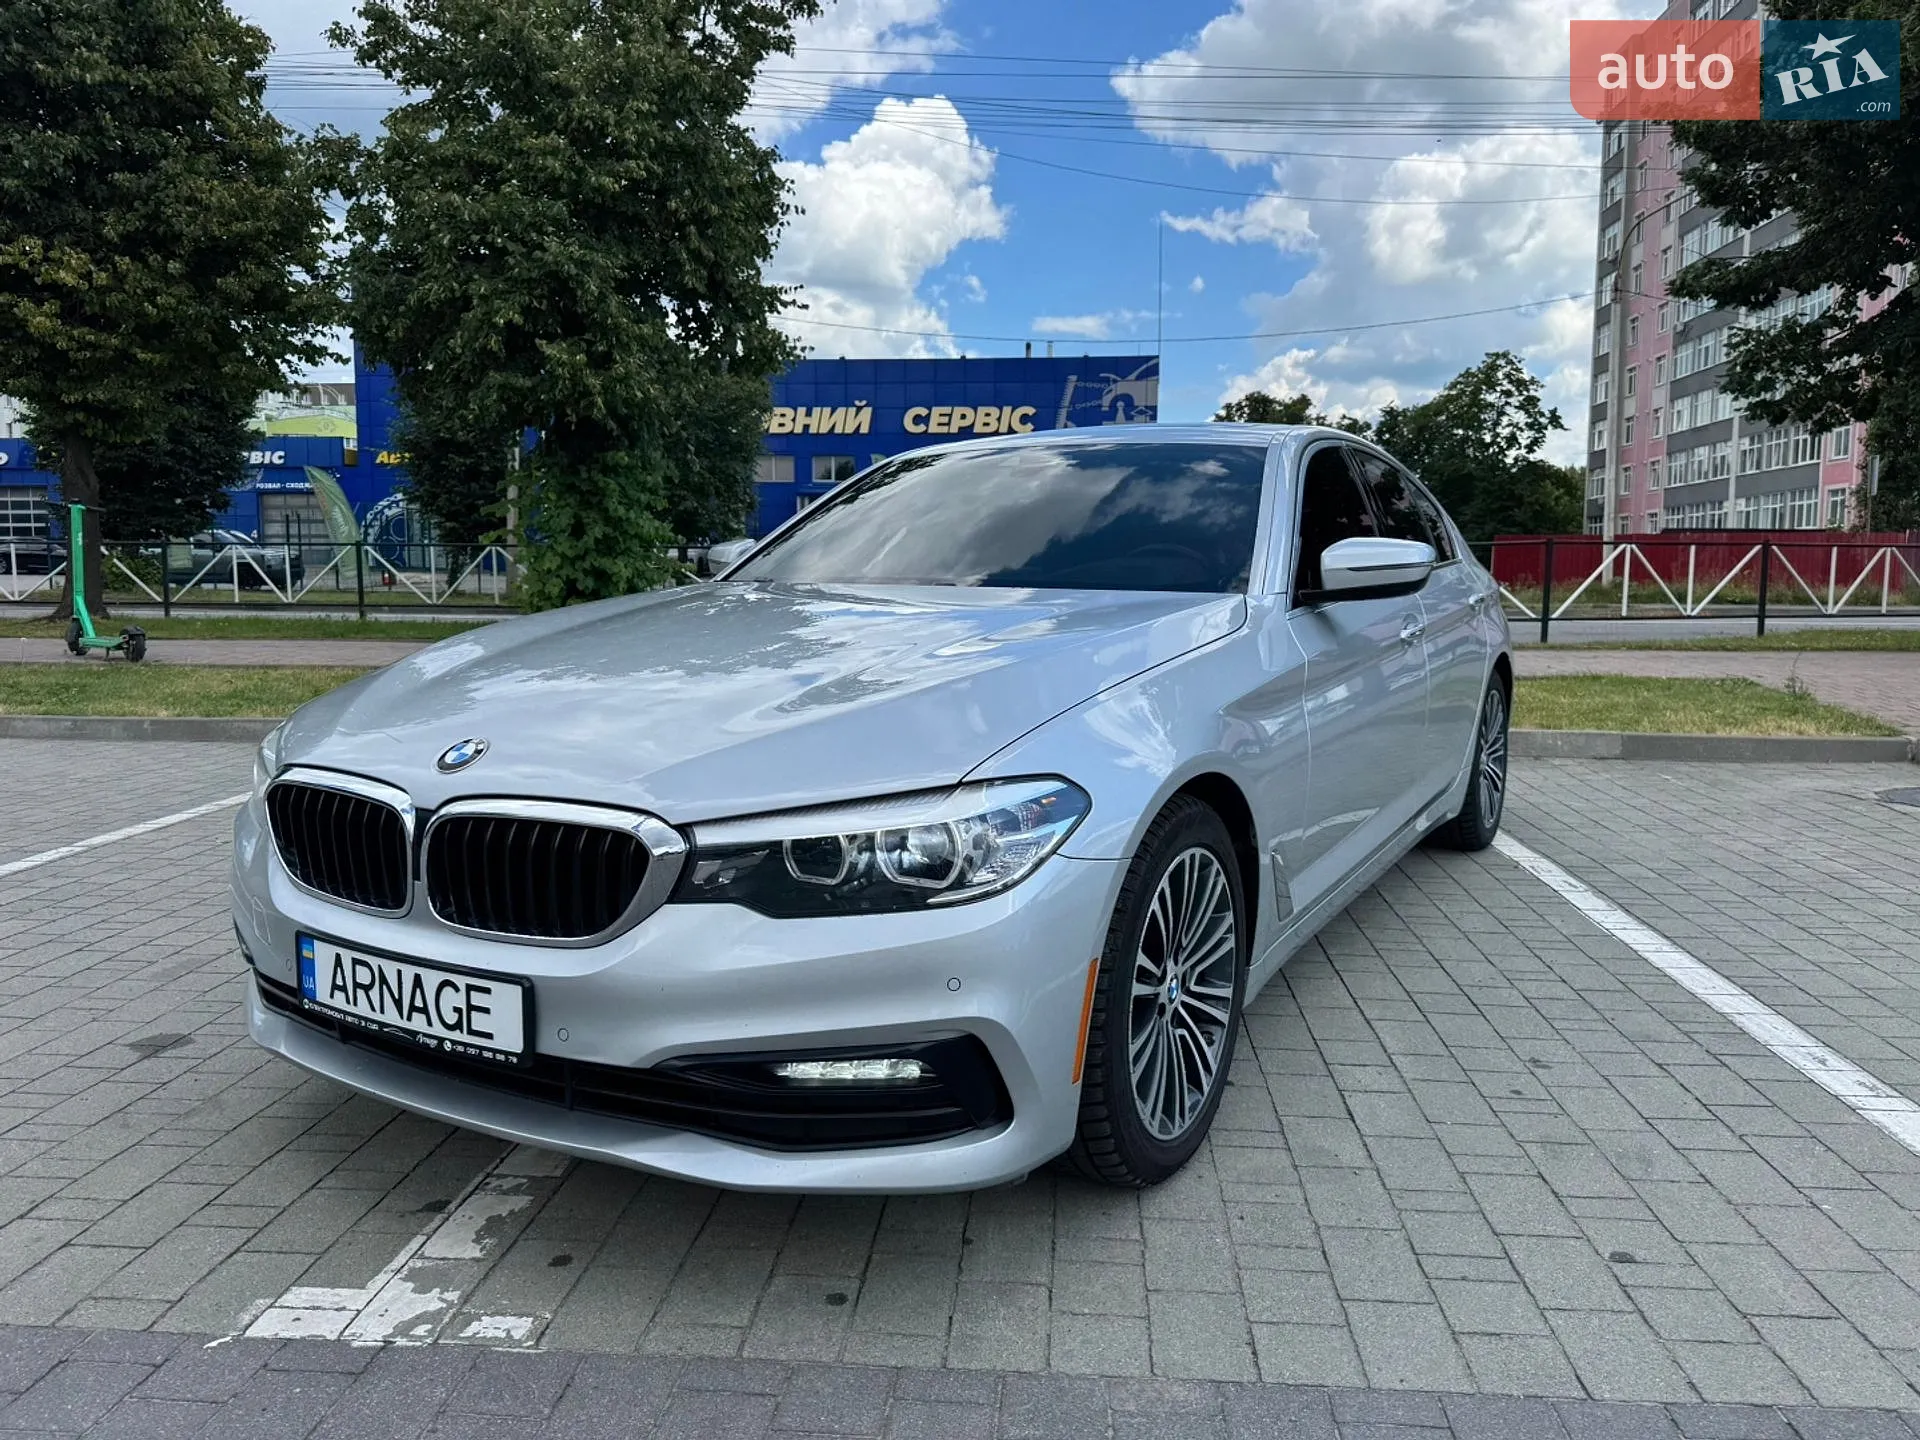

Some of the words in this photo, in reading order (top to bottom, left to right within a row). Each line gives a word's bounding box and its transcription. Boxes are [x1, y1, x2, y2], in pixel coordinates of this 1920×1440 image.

[763, 399, 873, 434] ВНИЙ
[903, 406, 1037, 434] СЕРВІС
[302, 973, 316, 990] UA
[329, 951, 494, 1041] ARNAGE
